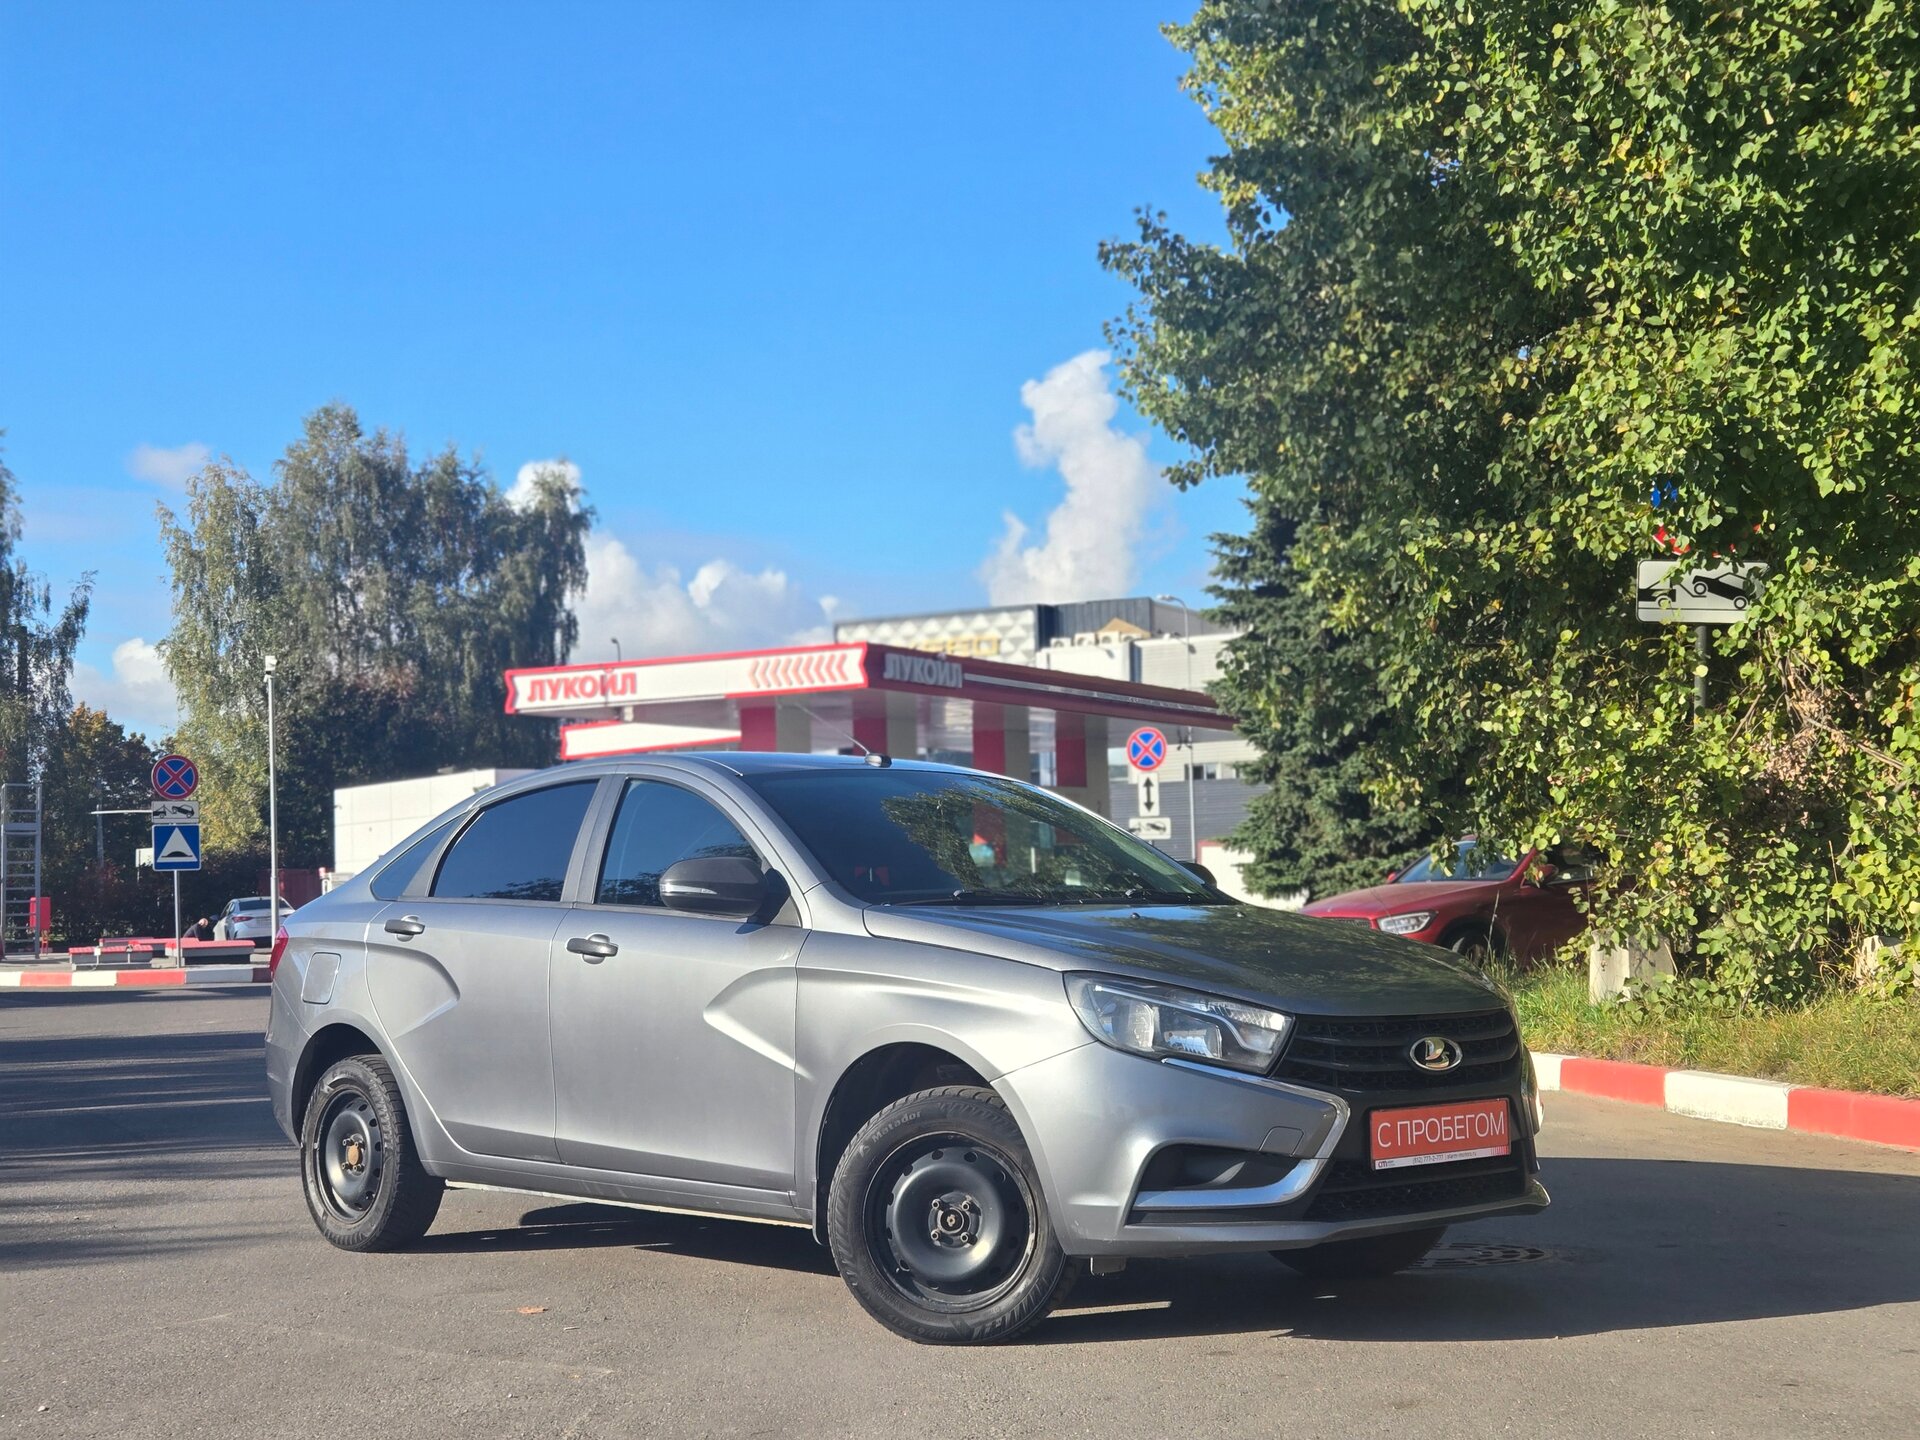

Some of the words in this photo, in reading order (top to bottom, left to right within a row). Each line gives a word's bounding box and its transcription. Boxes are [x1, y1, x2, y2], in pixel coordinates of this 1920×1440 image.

[527, 668, 637, 702] ЛУКОЙЛ
[883, 652, 963, 688] ЛУКОЙЛ
[872, 1112, 920, 1142] Matador
[1377, 1122, 1392, 1148] С
[1397, 1111, 1504, 1146] ПРОБЕГОМ
